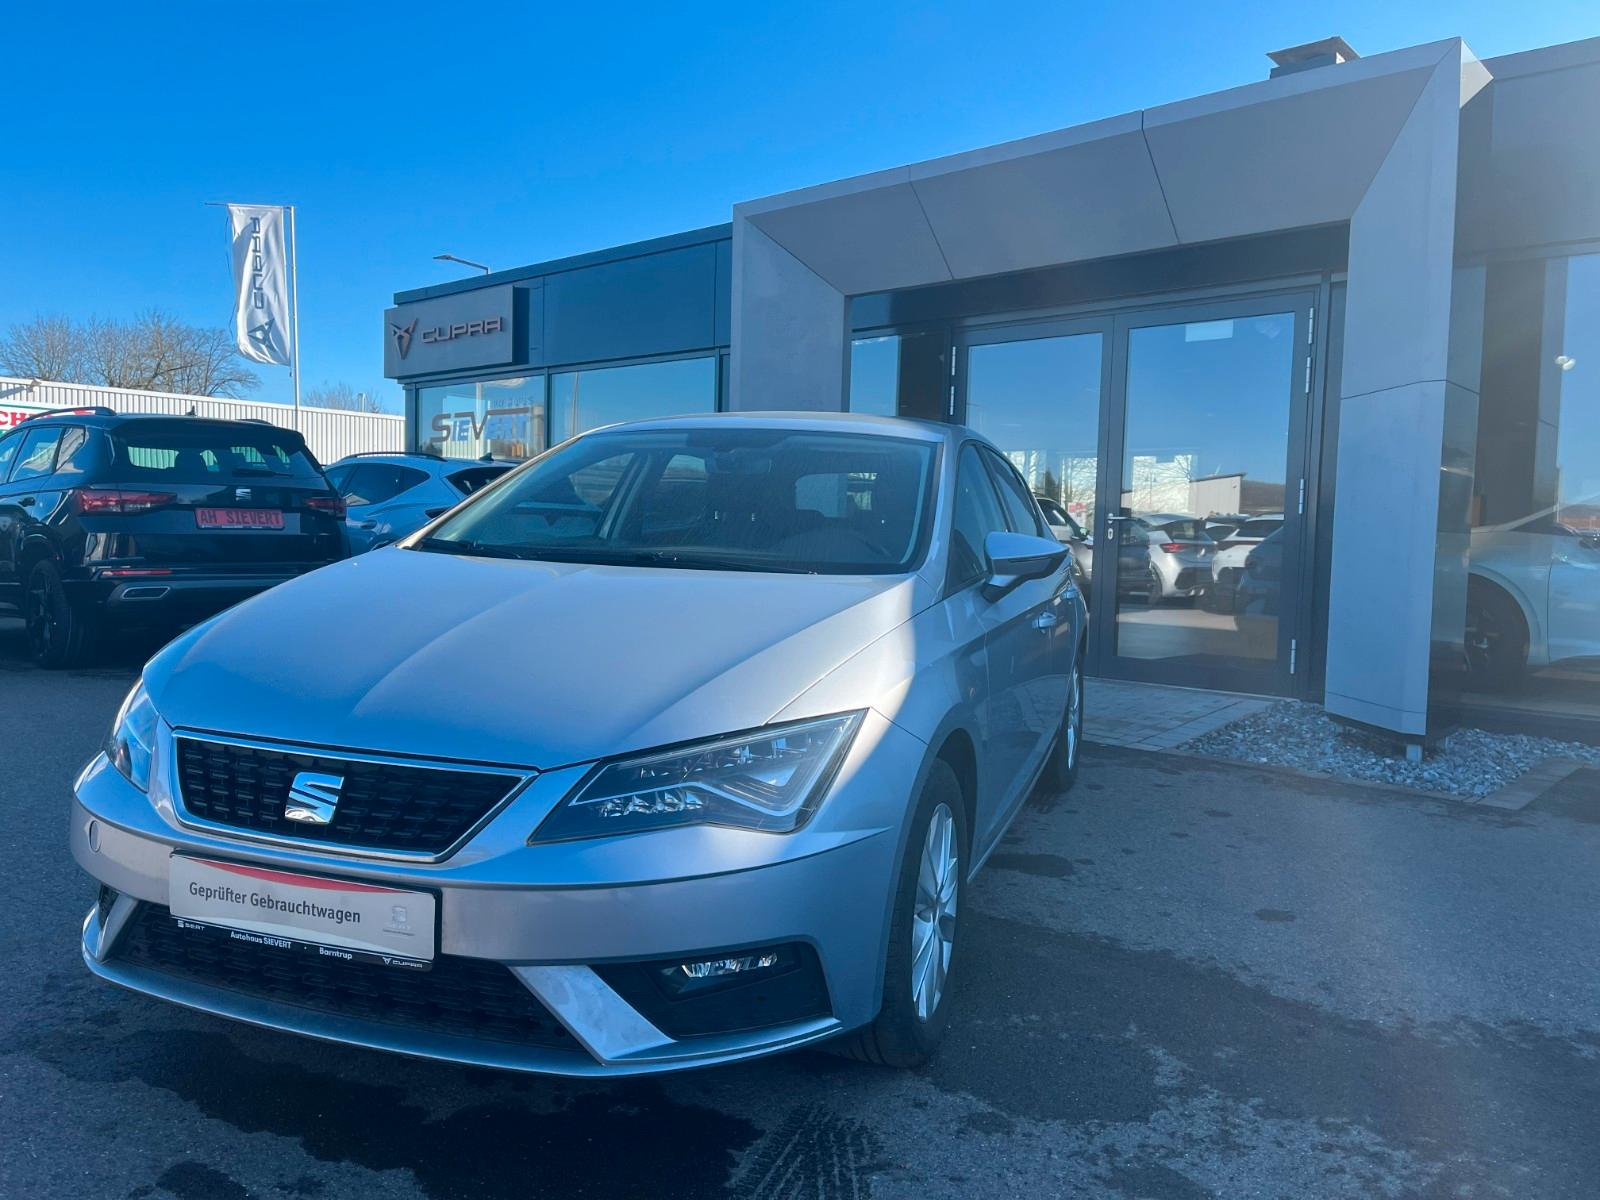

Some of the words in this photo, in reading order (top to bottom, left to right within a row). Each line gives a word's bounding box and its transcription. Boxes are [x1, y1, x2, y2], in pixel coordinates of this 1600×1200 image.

[250, 216, 264, 310] CUPRA
[421, 316, 503, 344] CUPRA
[430, 406, 531, 444] SIEVERT
[200, 509, 218, 524] AH
[226, 510, 280, 525] SIEVERT
[189, 881, 248, 905] Geprüfter
[250, 892, 361, 924] Gebrauchtwagen
[230, 930, 263, 944] Autohaus
[263, 936, 292, 949] SIEVERT
[319, 946, 353, 960] Barntrup
[392, 959, 423, 969] CUPRA
